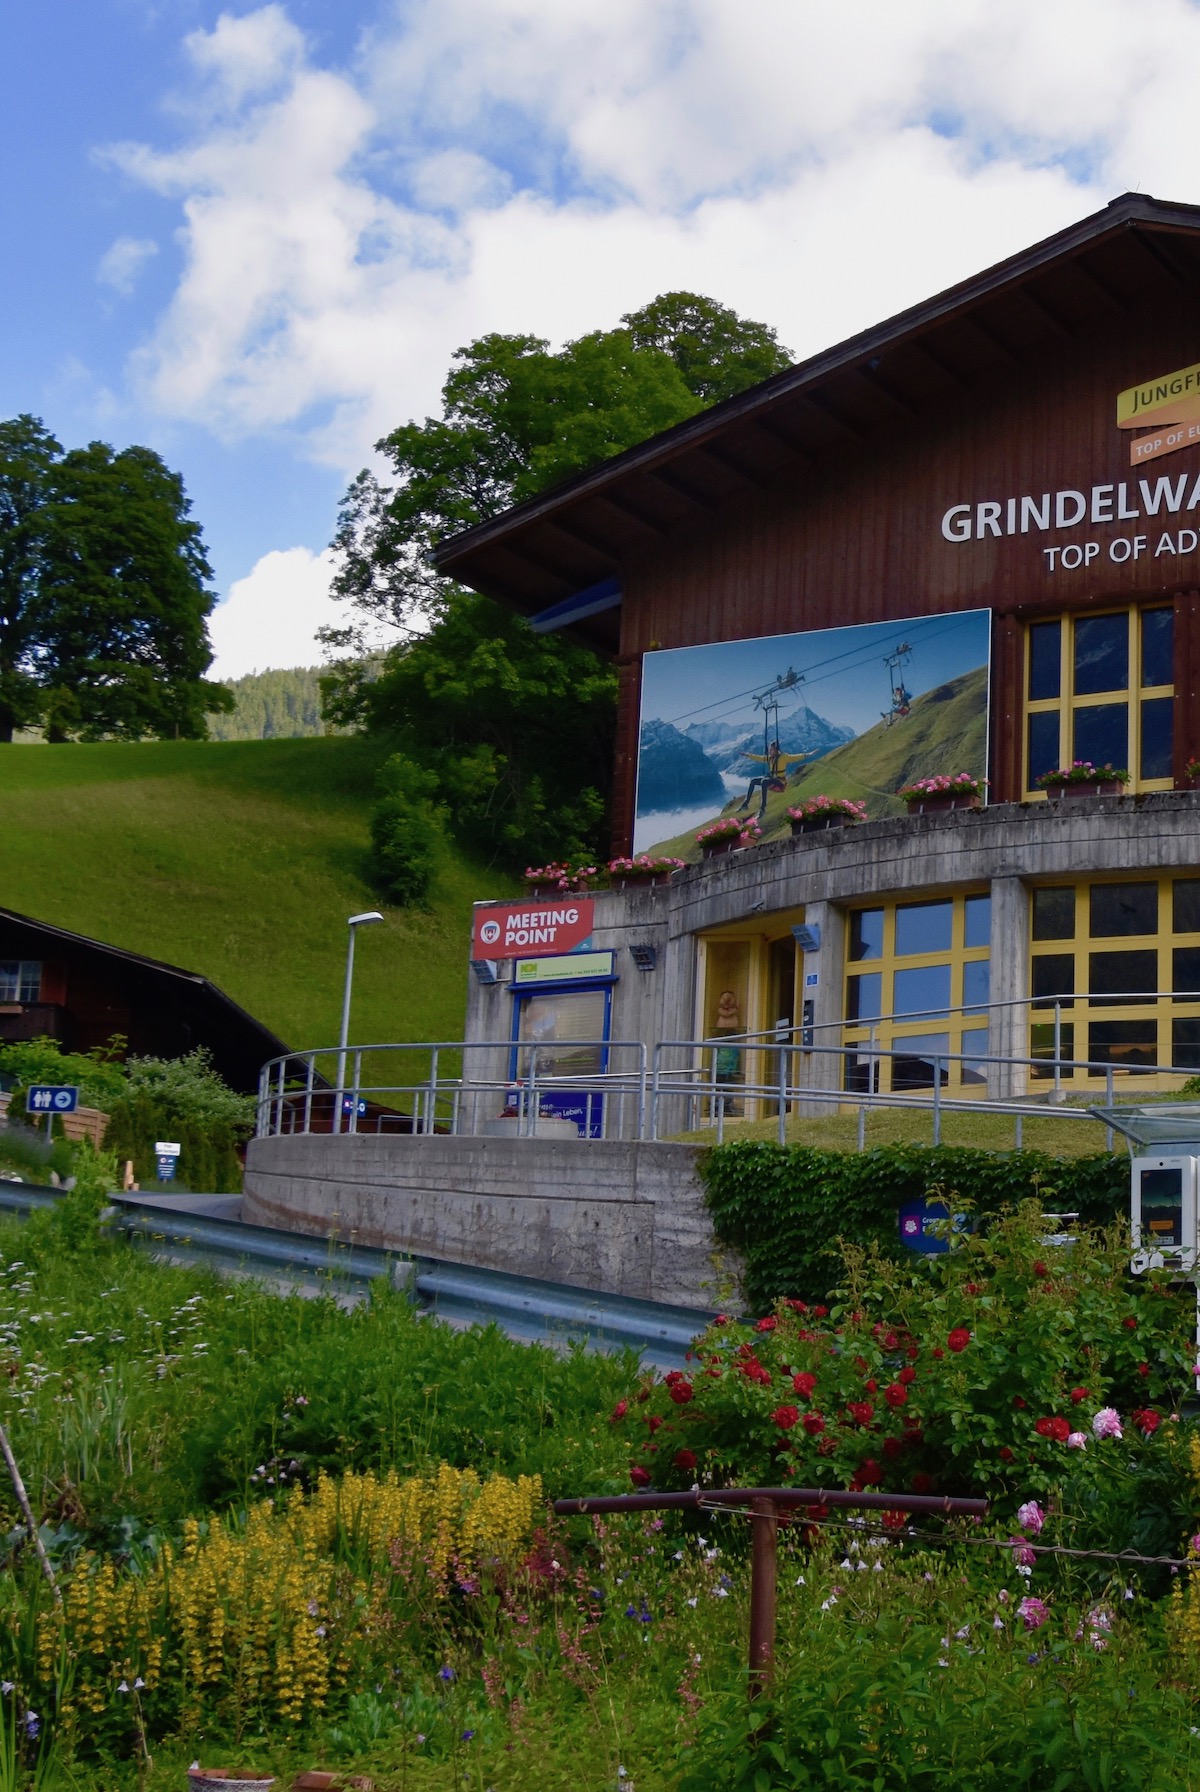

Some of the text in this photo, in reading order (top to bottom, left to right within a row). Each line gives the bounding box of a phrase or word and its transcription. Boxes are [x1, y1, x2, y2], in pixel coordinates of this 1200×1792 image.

[1136, 439, 1161, 458] TOP
[1166, 431, 1185, 447] OF
[1043, 543, 1100, 572] TOP
[1109, 536, 1147, 563] OF
[506, 908, 579, 930] MEETING
[504, 927, 557, 946] POINT
